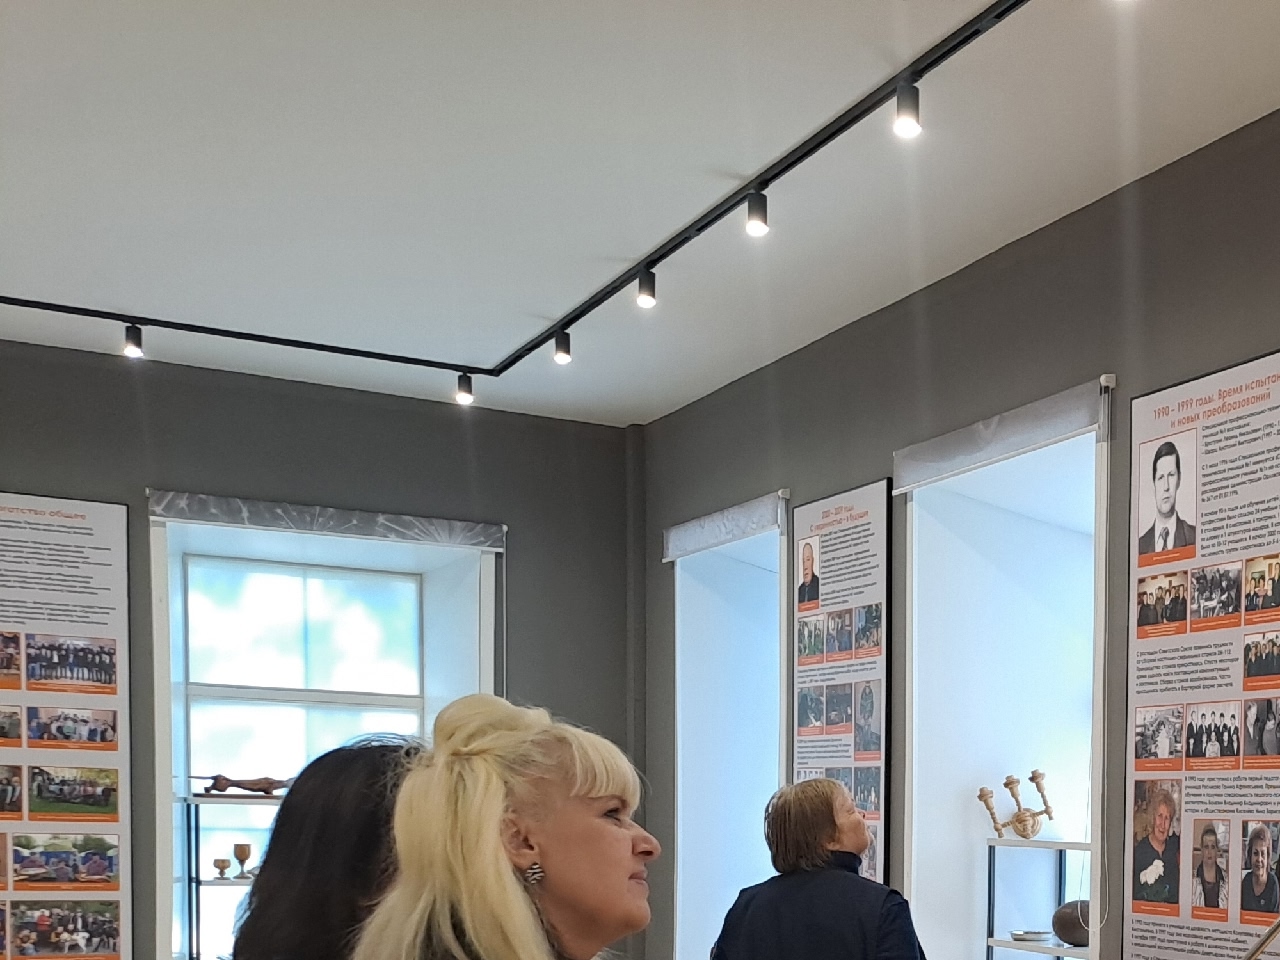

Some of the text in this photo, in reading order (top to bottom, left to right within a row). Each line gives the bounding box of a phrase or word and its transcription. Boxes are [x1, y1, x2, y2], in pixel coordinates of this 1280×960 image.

[1153, 404, 1170, 420] 1990
[1177, 397, 1194, 413] 1999
[1217, 384, 1243, 402] Время
[1170, 386, 1271, 429] и новых преобразований
